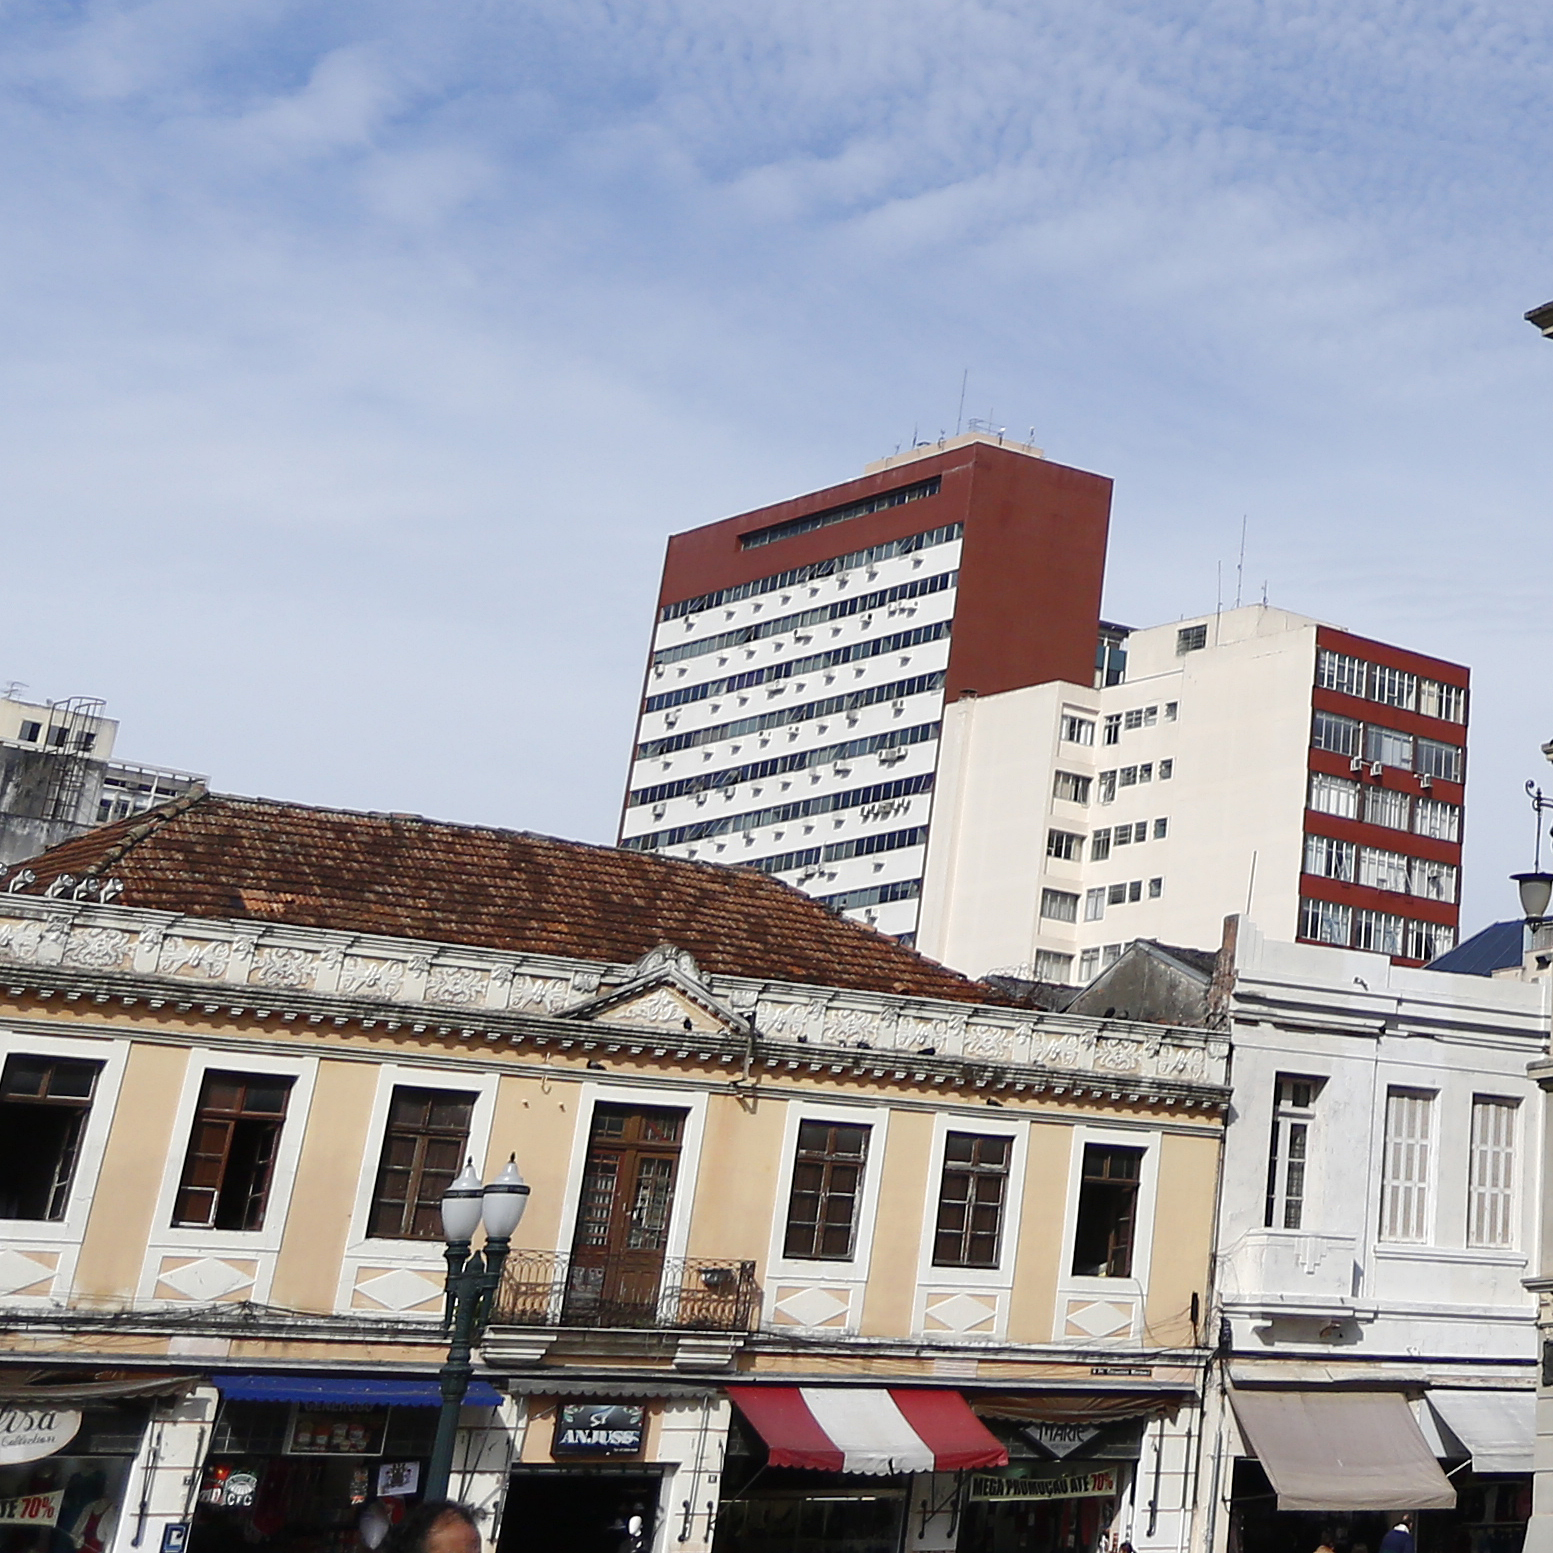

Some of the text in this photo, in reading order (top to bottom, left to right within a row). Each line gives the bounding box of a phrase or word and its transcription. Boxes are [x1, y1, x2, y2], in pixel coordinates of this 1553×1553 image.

[973, 1477, 1004, 1497] MEGA
[1090, 1472, 1113, 1491] 70%
[20, 1496, 56, 1519] 70%
